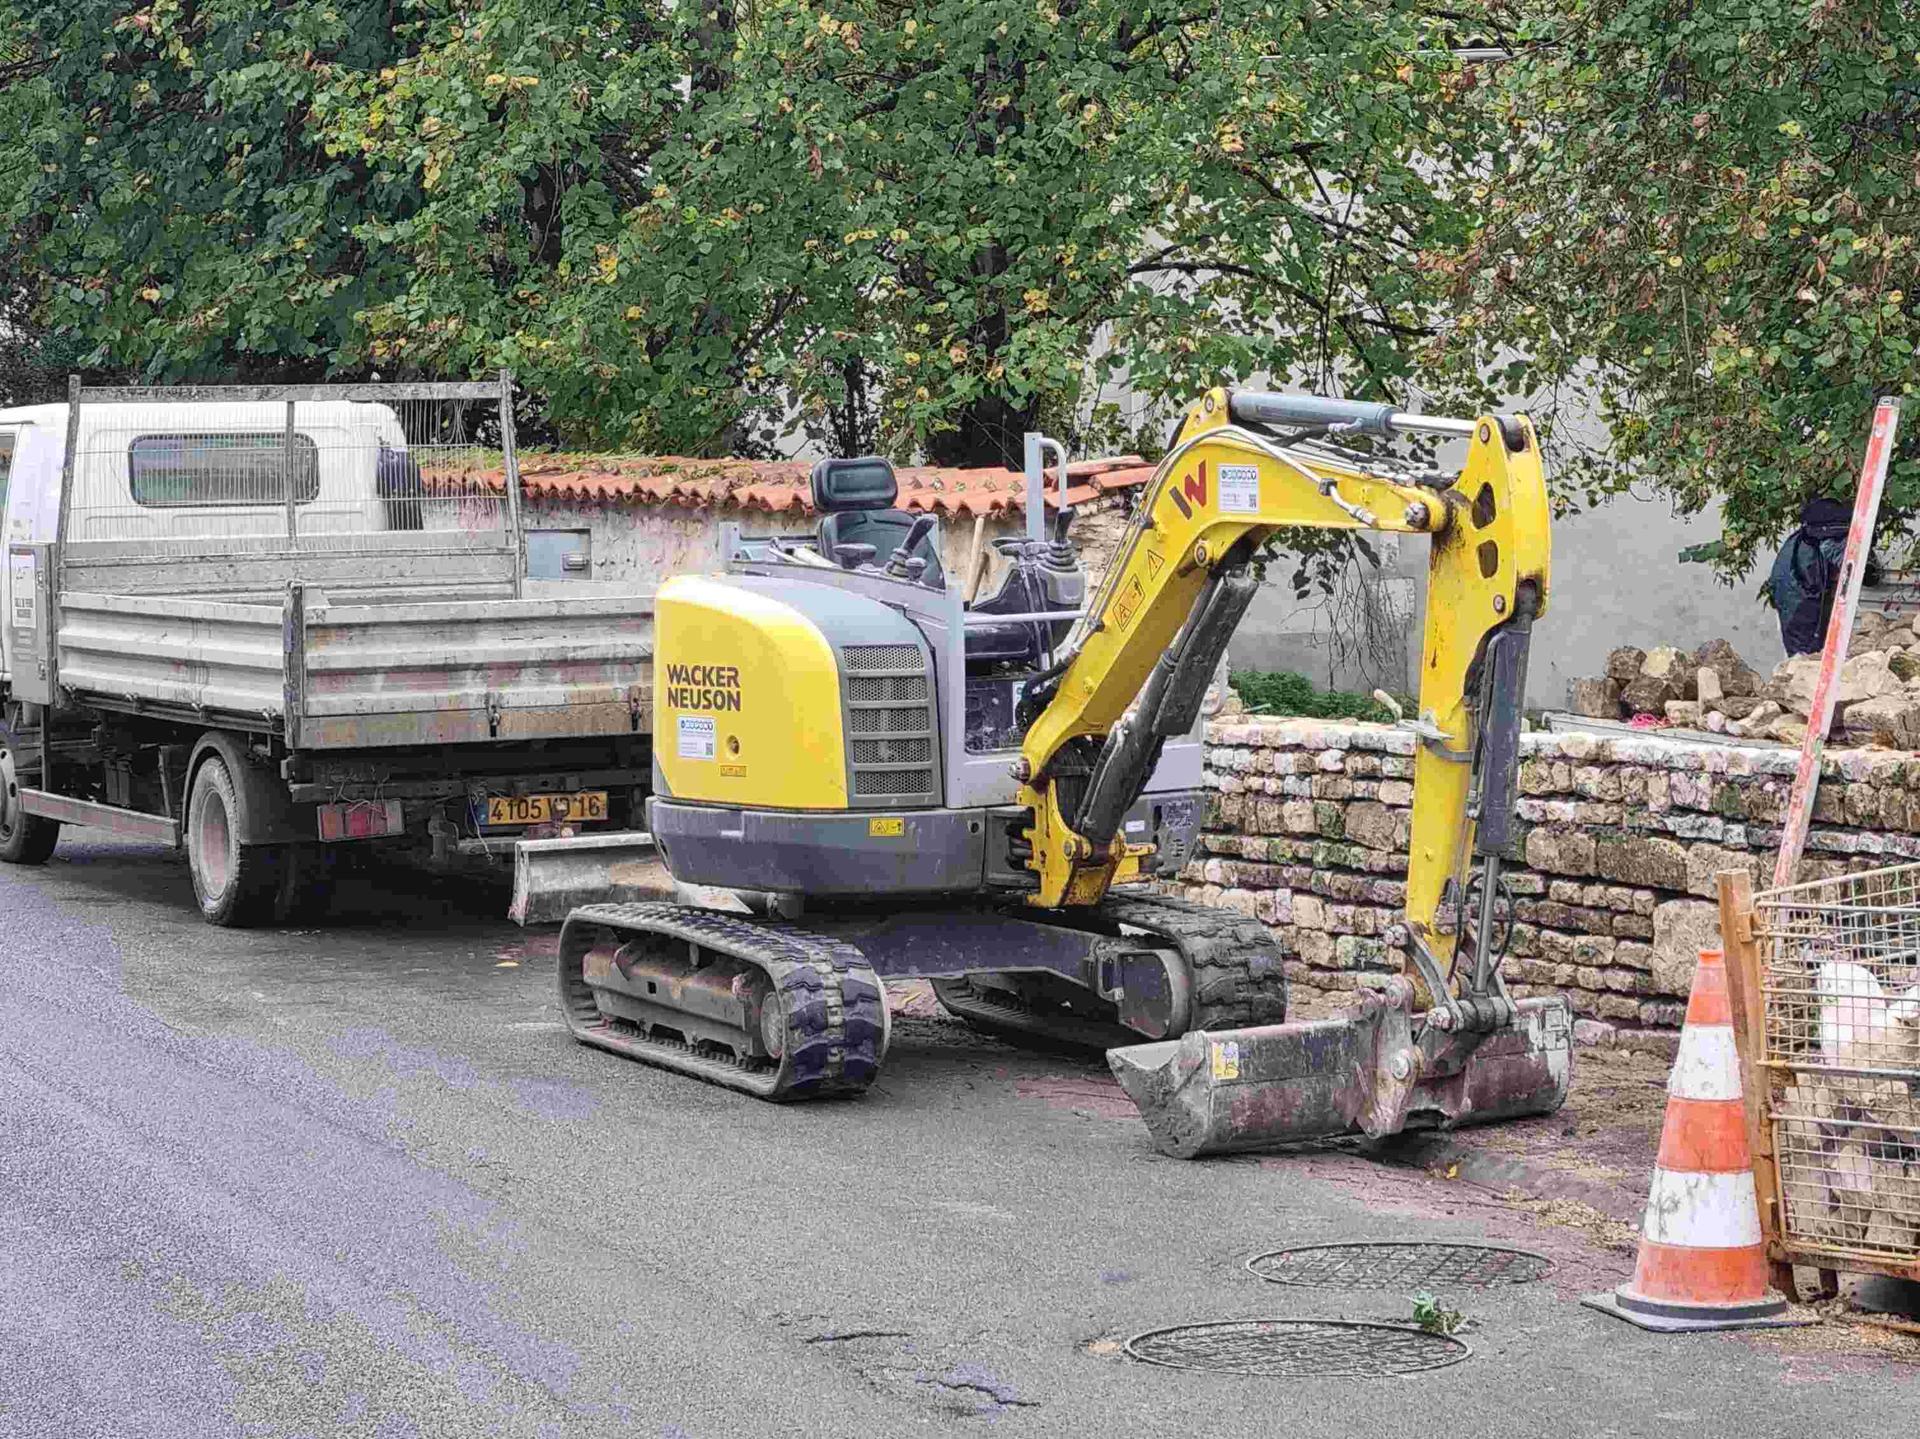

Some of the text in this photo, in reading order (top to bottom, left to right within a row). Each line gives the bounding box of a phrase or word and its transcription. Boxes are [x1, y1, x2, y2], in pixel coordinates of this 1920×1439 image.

[667, 663, 740, 688] WACKER
[667, 687, 741, 712] NEUSON
[491, 797, 542, 820] 4105
[578, 795, 601, 817] 16
